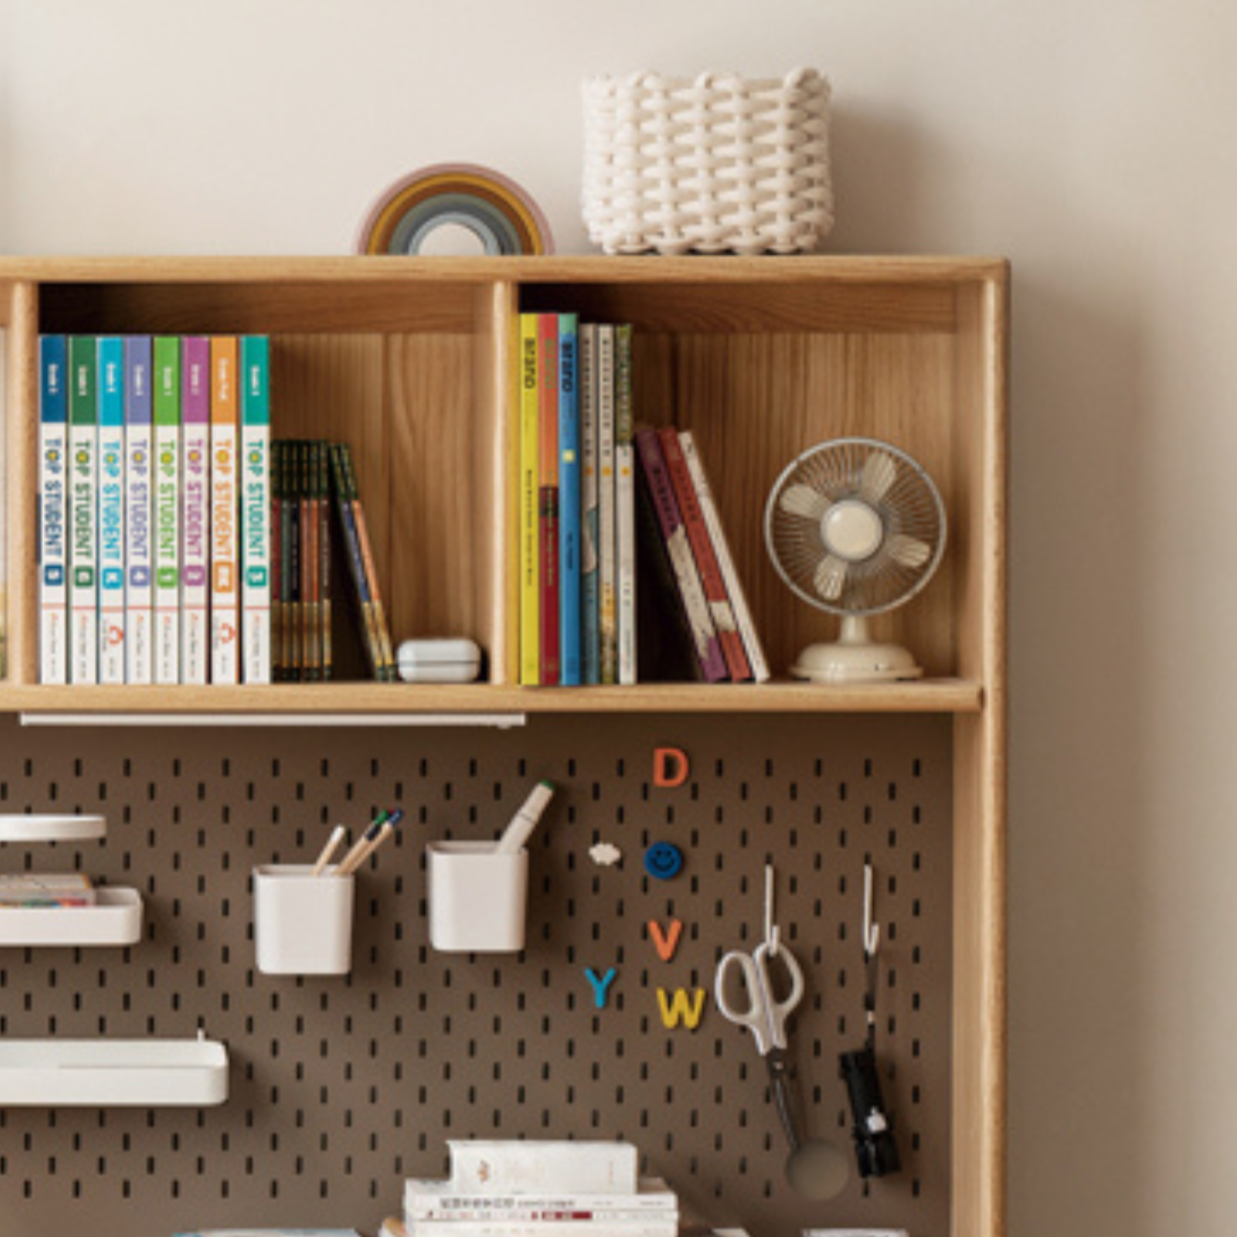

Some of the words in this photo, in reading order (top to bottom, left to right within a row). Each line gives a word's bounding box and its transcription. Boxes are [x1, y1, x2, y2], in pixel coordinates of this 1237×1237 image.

[45, 439, 62, 474] TOP
[75, 440, 91, 476] TOP
[103, 442, 120, 478] TOP
[131, 440, 147, 475] TOP
[159, 441, 175, 477] TOP
[187, 440, 203, 474] TOP
[215, 440, 232, 475] TOP
[247, 440, 264, 476] TOP
[44, 481, 62, 556] STUDENT
[75, 483, 91, 558] STUDENT
[103, 484, 120, 560] STUDENT
[131, 483, 147, 558] STUDENT
[159, 484, 175, 559] STUDENT
[187, 482, 203, 558] STUDENT
[215, 481, 232, 558] STUDENT
[247, 483, 264, 558] STUDENT
[653, 748, 689, 787] D
[648, 920, 682, 961] V
[585, 967, 616, 1008] Y
[657, 987, 705, 1029] W
